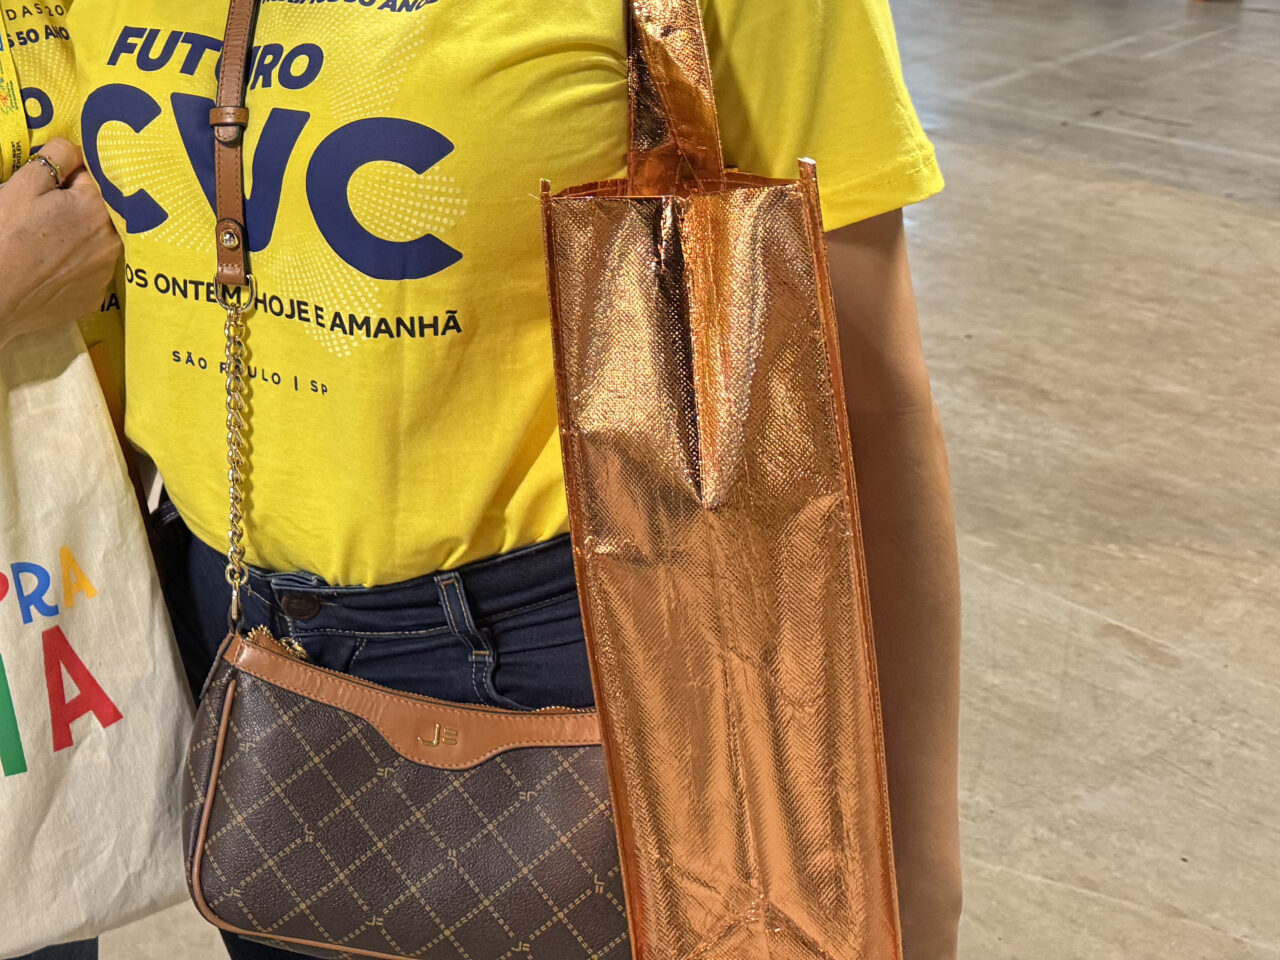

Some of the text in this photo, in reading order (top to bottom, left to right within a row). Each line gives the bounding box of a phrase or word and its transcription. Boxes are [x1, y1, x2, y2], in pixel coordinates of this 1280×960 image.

[18, 28, 40, 46] 50
[107, 25, 325, 91] FUTRO
[80, 83, 463, 280] CVC
[254, 292, 311, 323] HOJE
[315, 304, 325, 327] E
[330, 309, 463, 339] AMANHÃ
[172, 349, 208, 370] SÃO
[310, 379, 329, 396] SP
